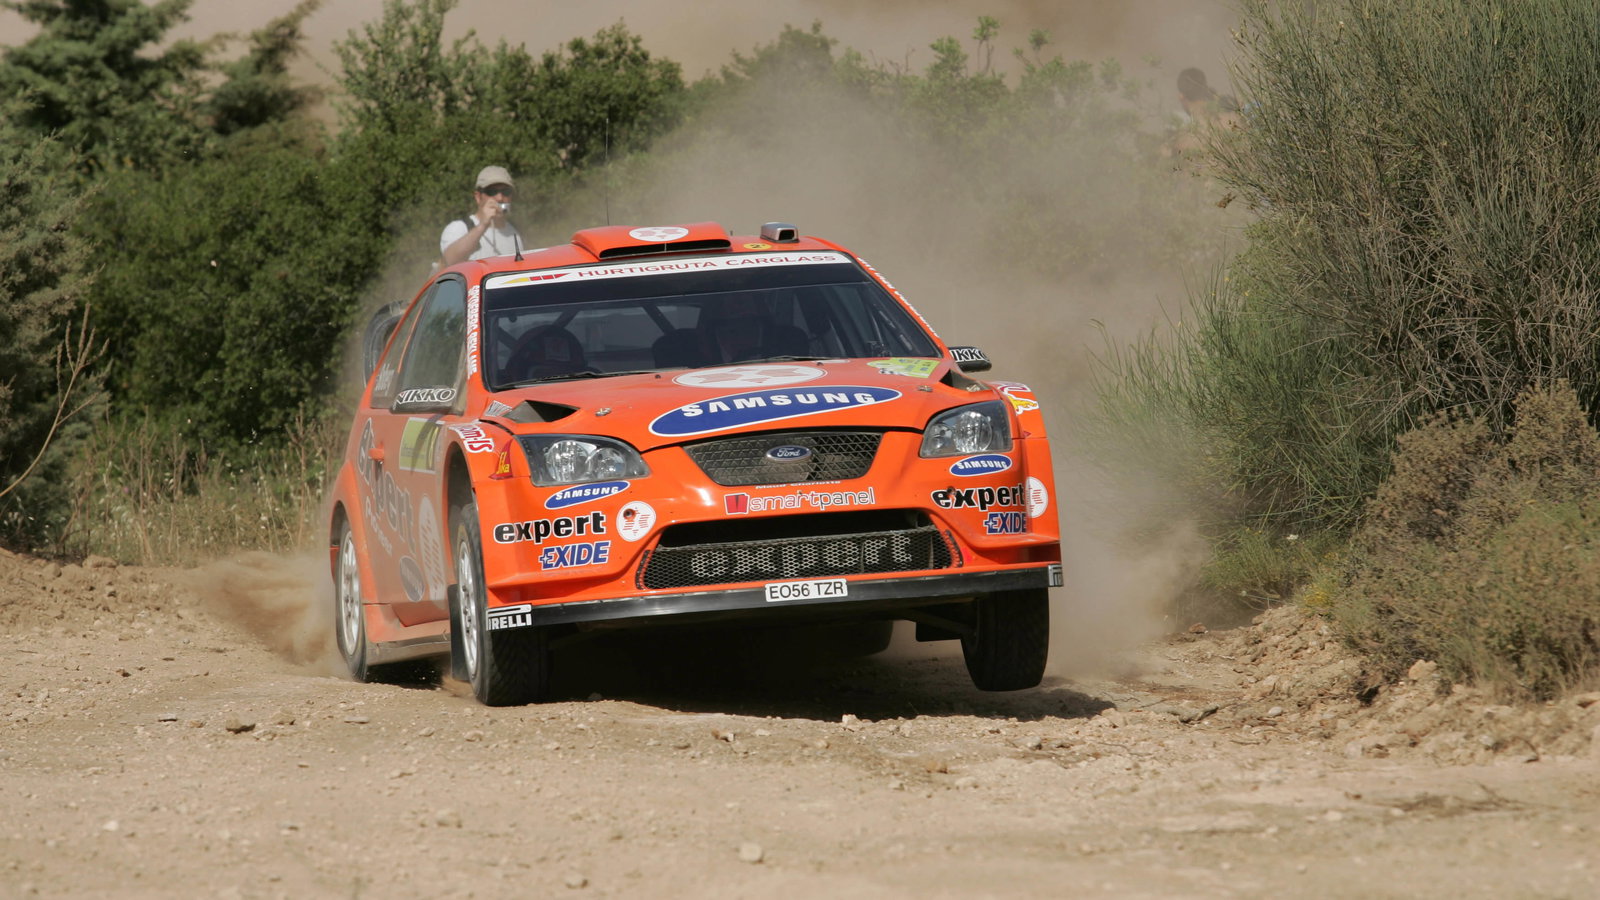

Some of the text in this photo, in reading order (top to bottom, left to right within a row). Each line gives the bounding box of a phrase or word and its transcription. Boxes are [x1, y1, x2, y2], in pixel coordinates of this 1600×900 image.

[578, 254, 837, 277] HURTIGRUTA CARGLASS
[681, 392, 876, 417] SAMSUNG
[776, 447, 801, 458] Ford
[957, 460, 1008, 470] SAMSUNG
[555, 486, 620, 501] SAMSUNG
[749, 487, 876, 511] smartpanel
[930, 483, 1026, 512] expert
[493, 511, 606, 545] expert
[983, 511, 1028, 535] EXIDE
[538, 540, 611, 571] EXIDE
[691, 530, 912, 578] expert
[769, 581, 844, 599] EO56 TZR
